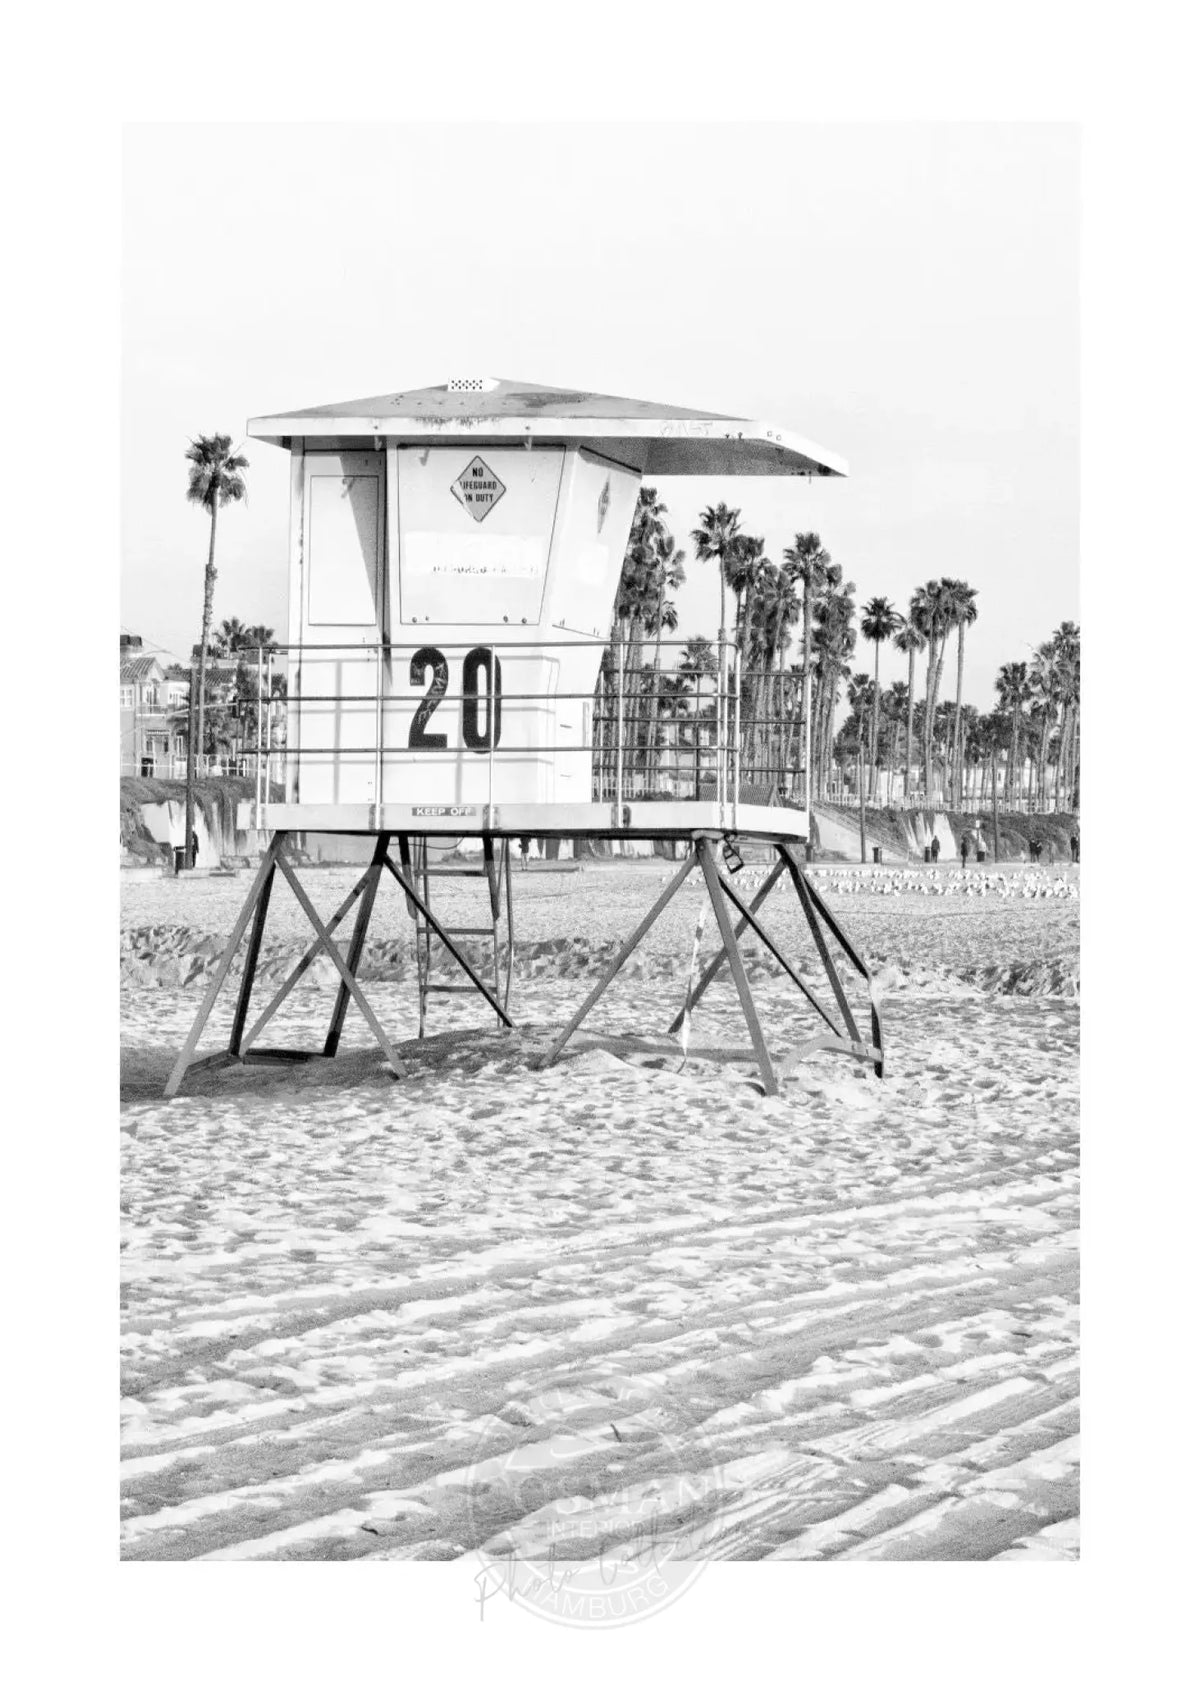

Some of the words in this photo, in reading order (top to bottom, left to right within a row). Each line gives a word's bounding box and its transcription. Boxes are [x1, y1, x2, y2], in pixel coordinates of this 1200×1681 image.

[472, 467, 484, 477] NO
[475, 493, 494, 502] DUTY
[408, 646, 502, 754] 20
[416, 808, 446, 816] KEEP
[450, 808, 472, 816] OFF
